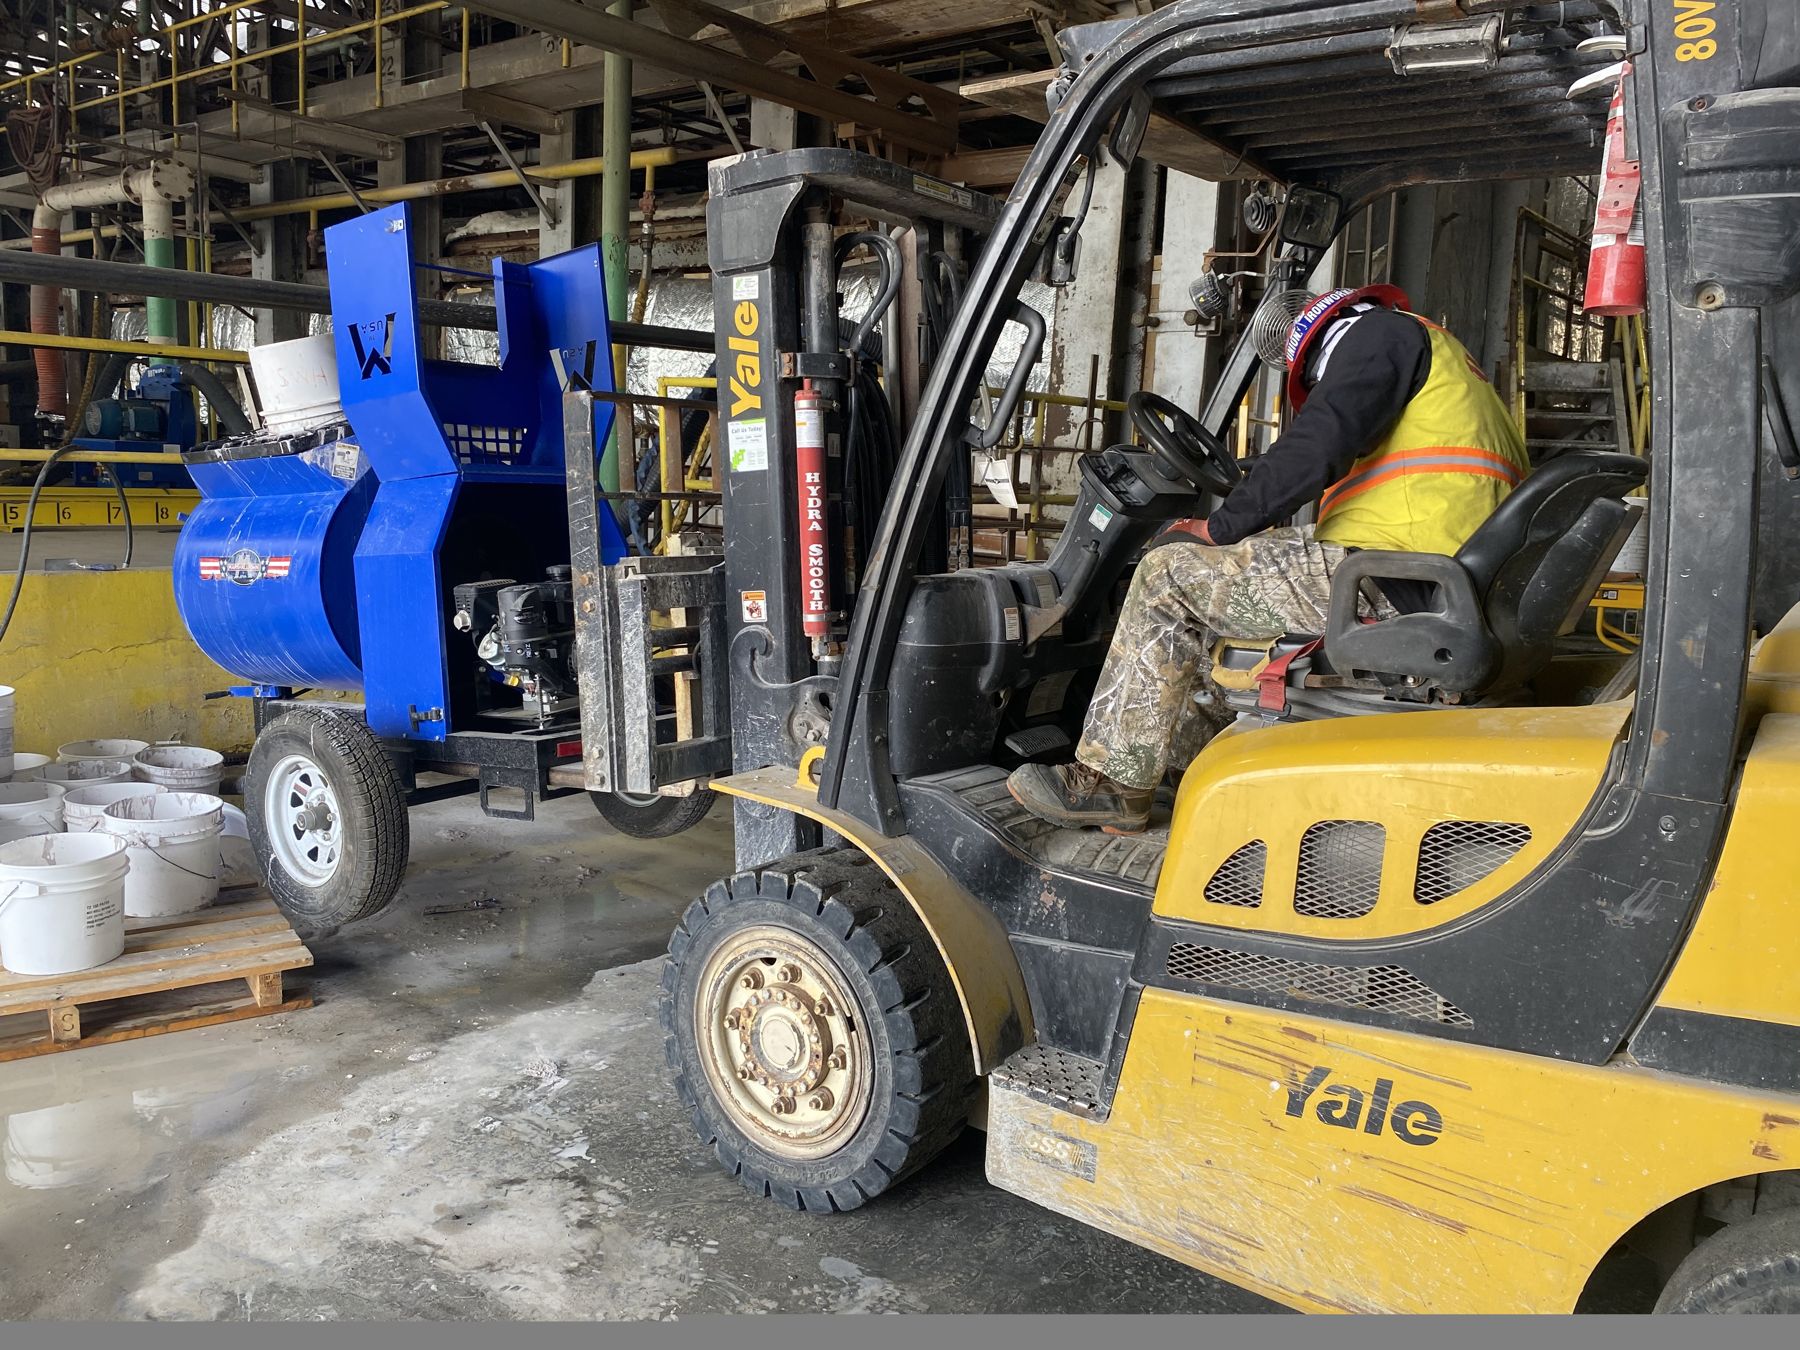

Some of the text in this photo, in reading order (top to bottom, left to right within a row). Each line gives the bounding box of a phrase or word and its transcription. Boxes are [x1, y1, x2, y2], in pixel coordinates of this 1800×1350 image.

[728, 300, 762, 418] Yale
[9, 507, 170, 520] 5 6 7 8
[805, 472, 823, 531] HYDRA
[808, 544, 825, 611] SMOOTH
[1283, 1065, 1443, 1146] Yale
